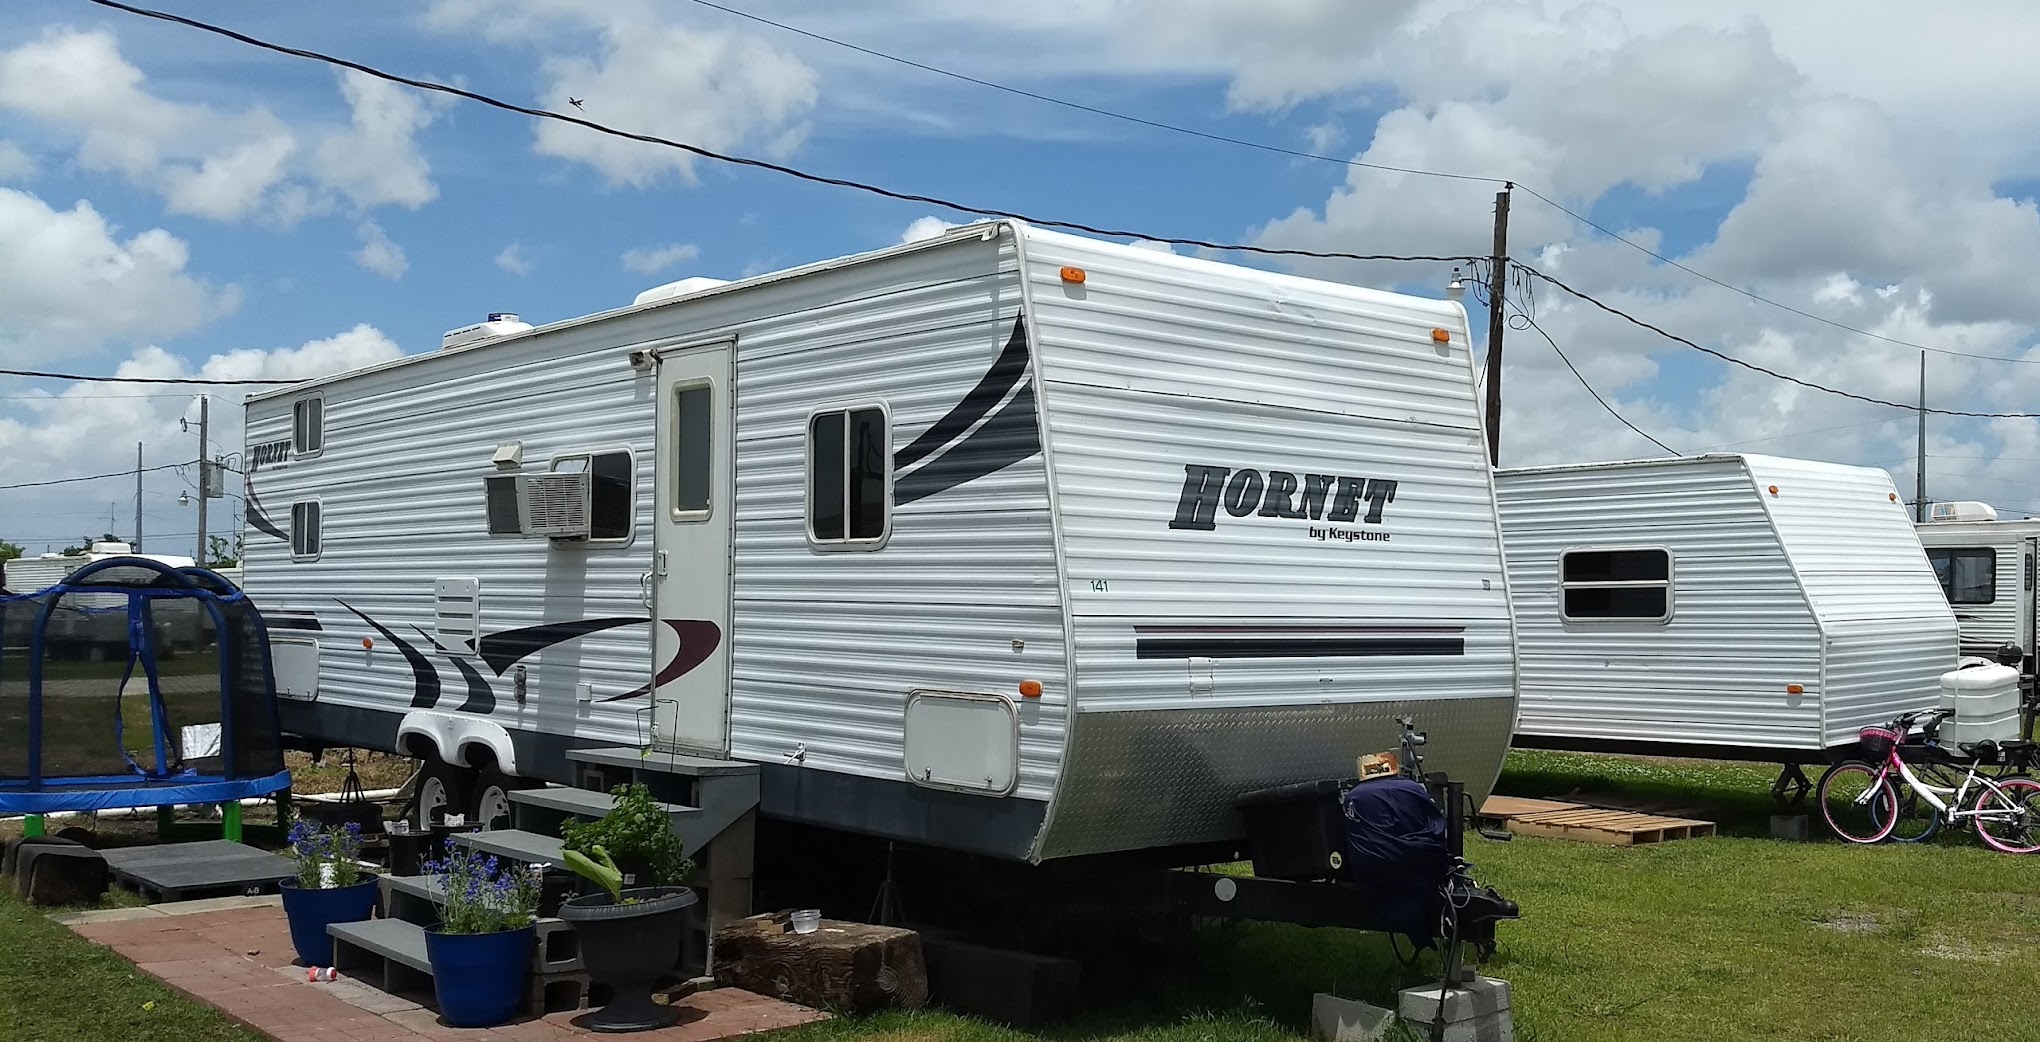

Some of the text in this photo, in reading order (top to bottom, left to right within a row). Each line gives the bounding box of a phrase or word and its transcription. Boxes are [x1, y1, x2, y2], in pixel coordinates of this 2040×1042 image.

[250, 441, 292, 472] HORNET
[1168, 464, 1398, 531] HORNET
[1309, 526, 1391, 542] by Keystone
[1090, 579, 1109, 592] 141
